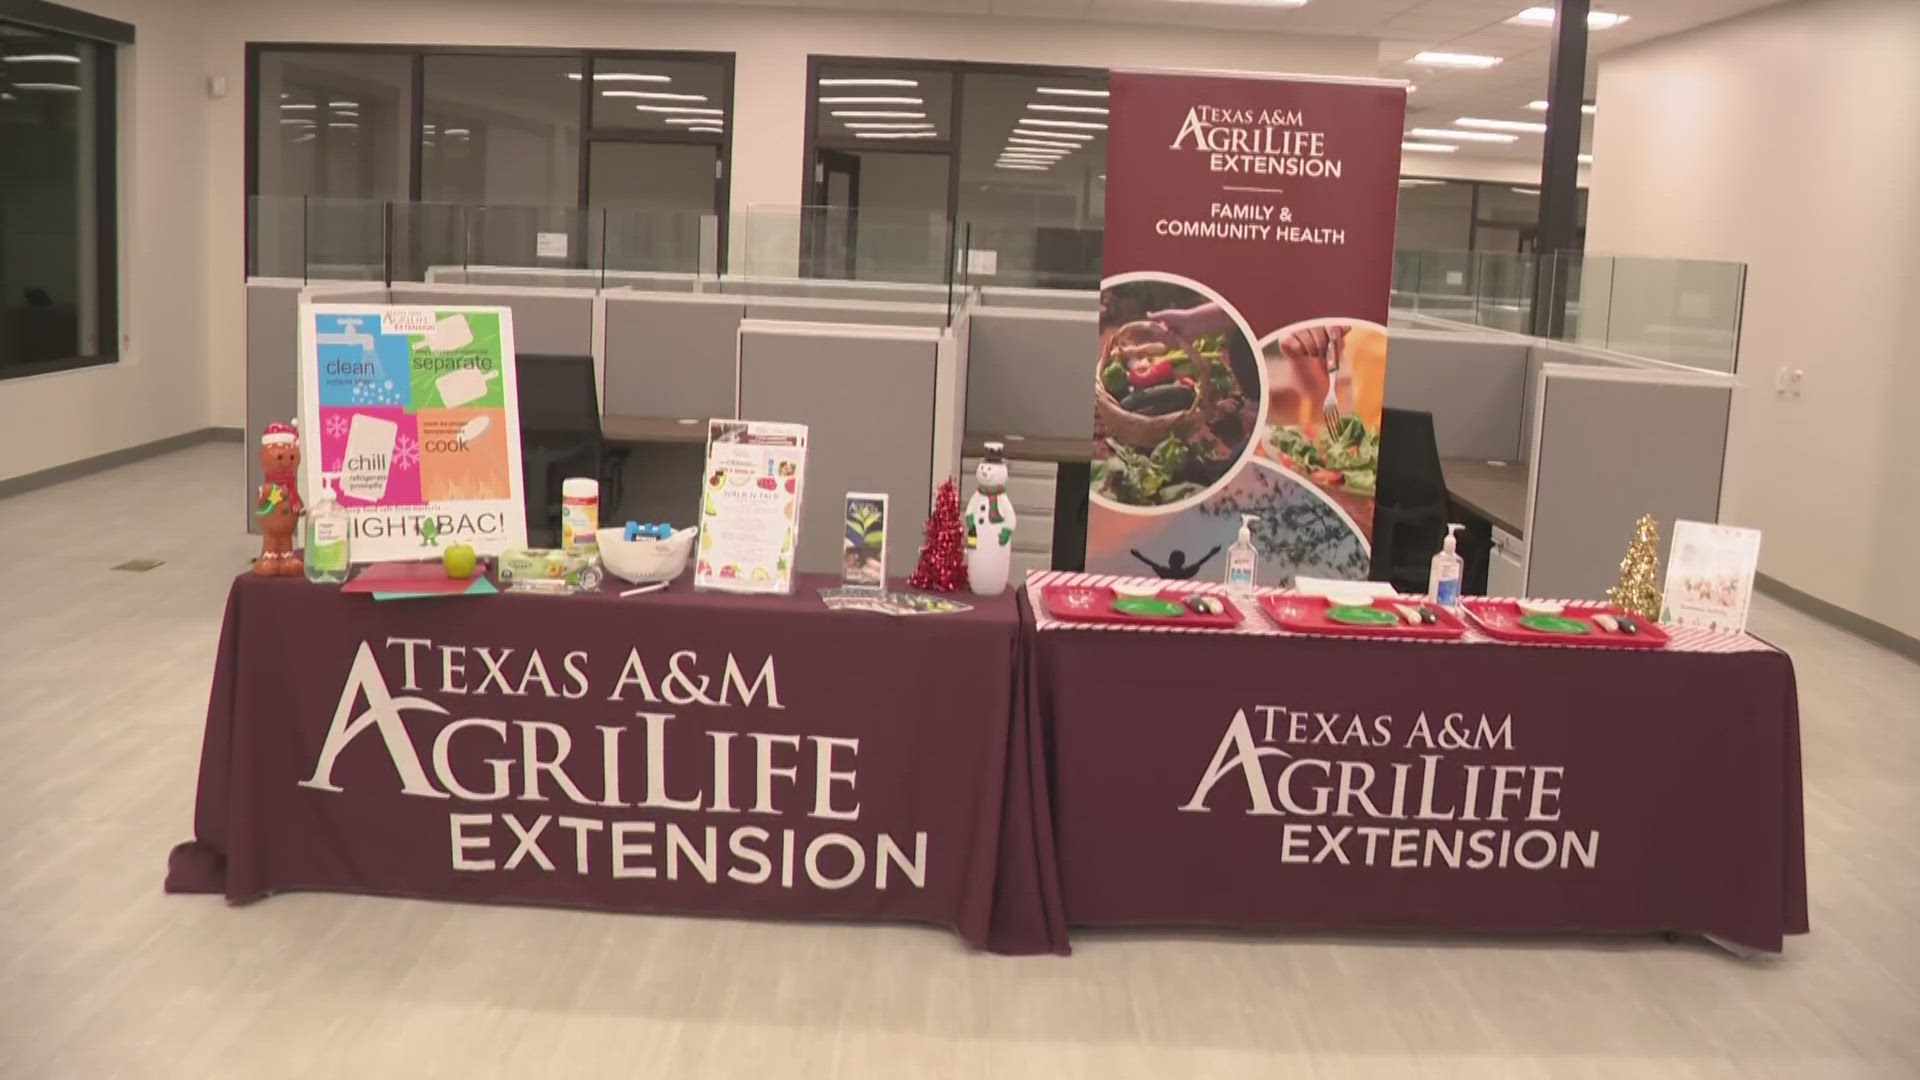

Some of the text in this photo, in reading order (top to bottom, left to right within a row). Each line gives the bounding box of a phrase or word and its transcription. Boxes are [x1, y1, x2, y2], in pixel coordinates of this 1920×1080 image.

[1198, 105, 1303, 127] TEXAS A&M
[1210, 153, 1342, 178] EXTENSION
[1211, 203, 1292, 222] FAMILY &
[1156, 219, 1345, 245] COMMUNITY HEALTH
[326, 358, 375, 376] clean
[413, 354, 492, 374] separate
[425, 436, 470, 452] cook
[348, 454, 386, 471] chill
[353, 514, 426, 539] IGHT
[436, 512, 505, 536] BAC!
[386, 636, 785, 709] TEXAS A&M
[1255, 705, 1516, 751] TEXAS A&M
[450, 812, 928, 890] EXTENSION
[1281, 823, 1599, 870] EXTENSION
